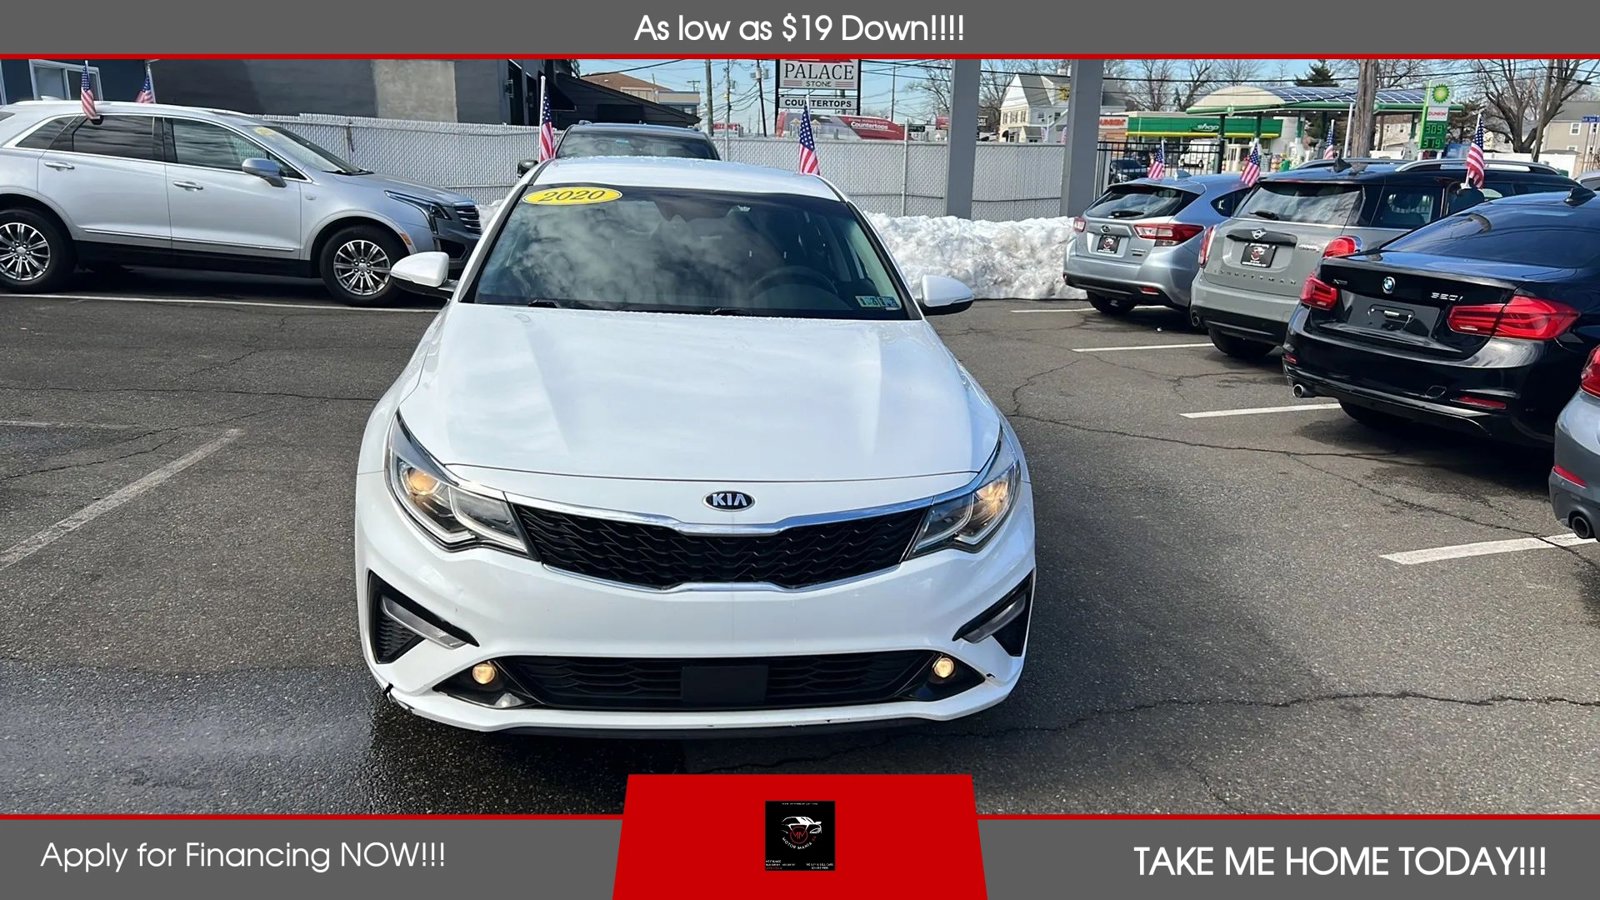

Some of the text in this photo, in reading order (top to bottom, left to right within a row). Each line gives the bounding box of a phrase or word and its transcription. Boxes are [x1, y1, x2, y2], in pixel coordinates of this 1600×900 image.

[784, 63, 854, 80] PALACE
[805, 80, 832, 88] STONE
[537, 190, 606, 203] 2020
[712, 493, 748, 507] KIA
